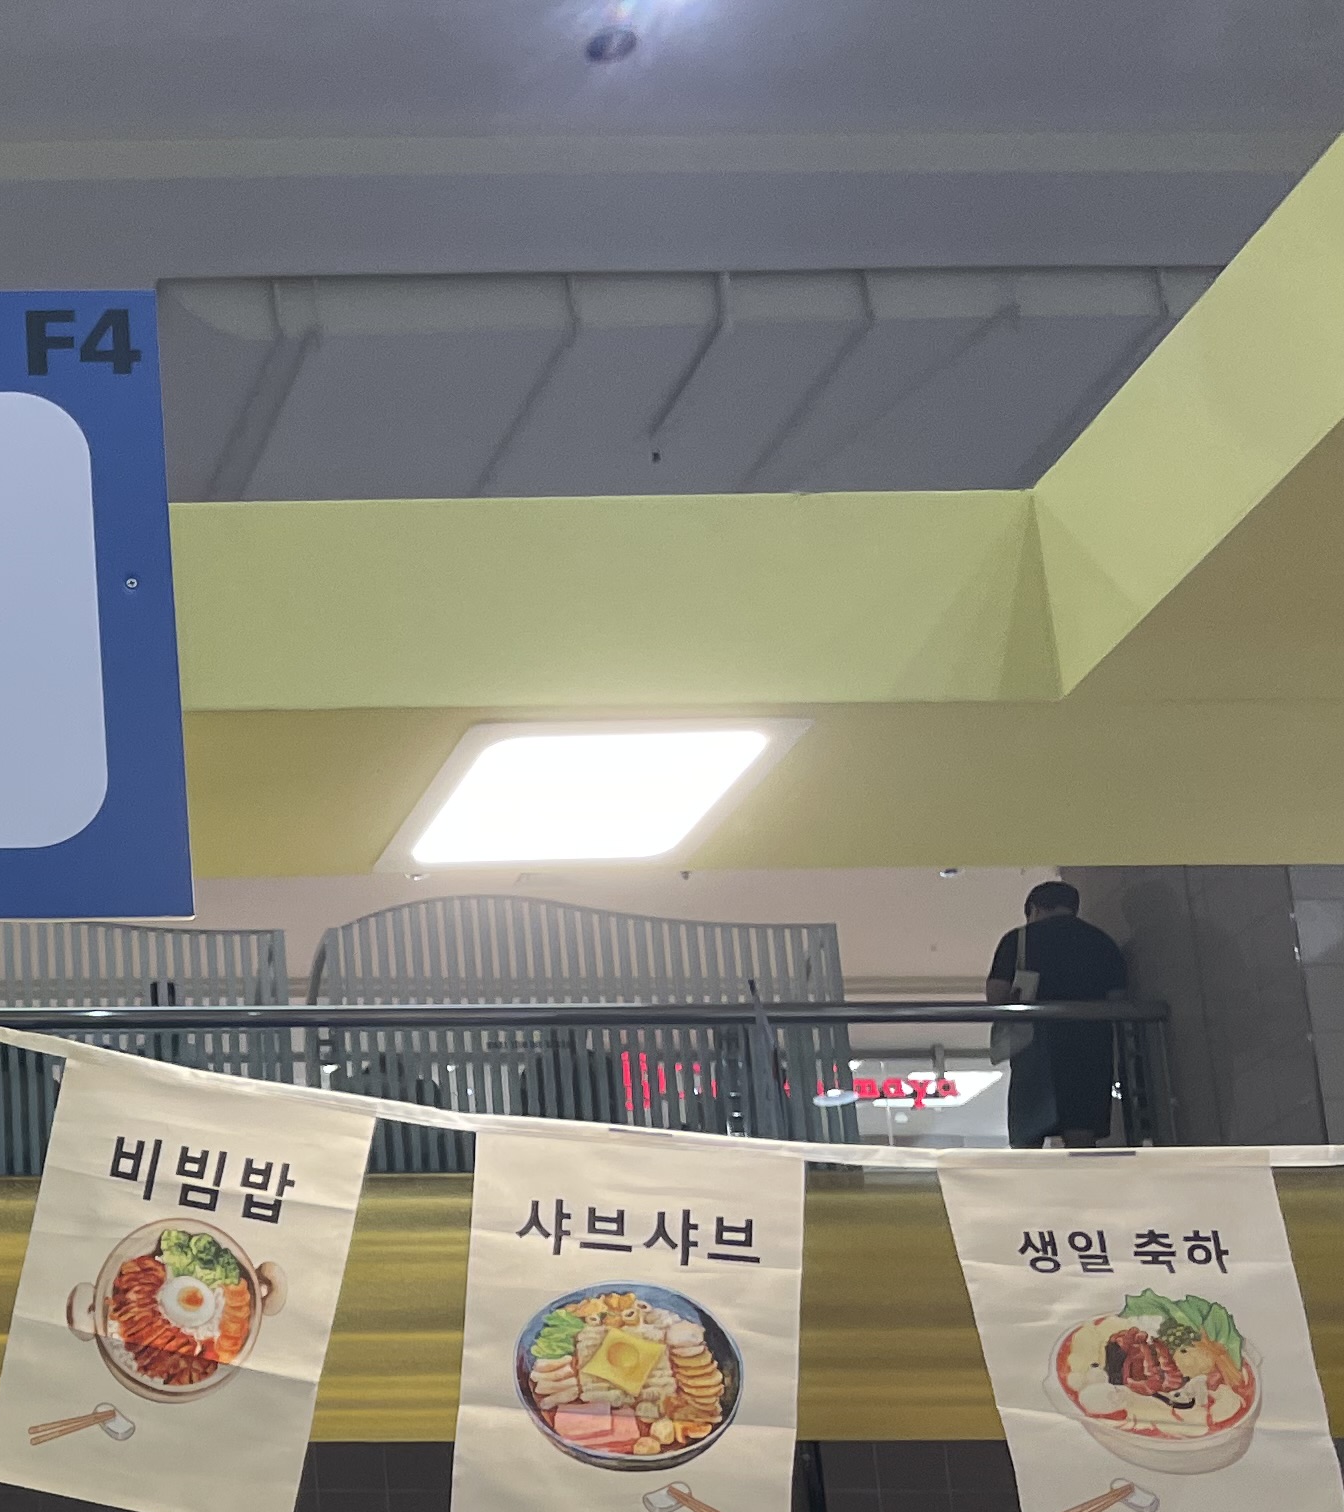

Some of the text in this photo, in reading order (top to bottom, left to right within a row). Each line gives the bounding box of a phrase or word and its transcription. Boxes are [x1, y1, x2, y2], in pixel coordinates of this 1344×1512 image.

[23, 307, 141, 378] F4
[109, 1136, 295, 1225] 비빔밥
[515, 1199, 761, 1267] 샤브샤브
[1018, 1229, 1230, 1274] 생일 축하
